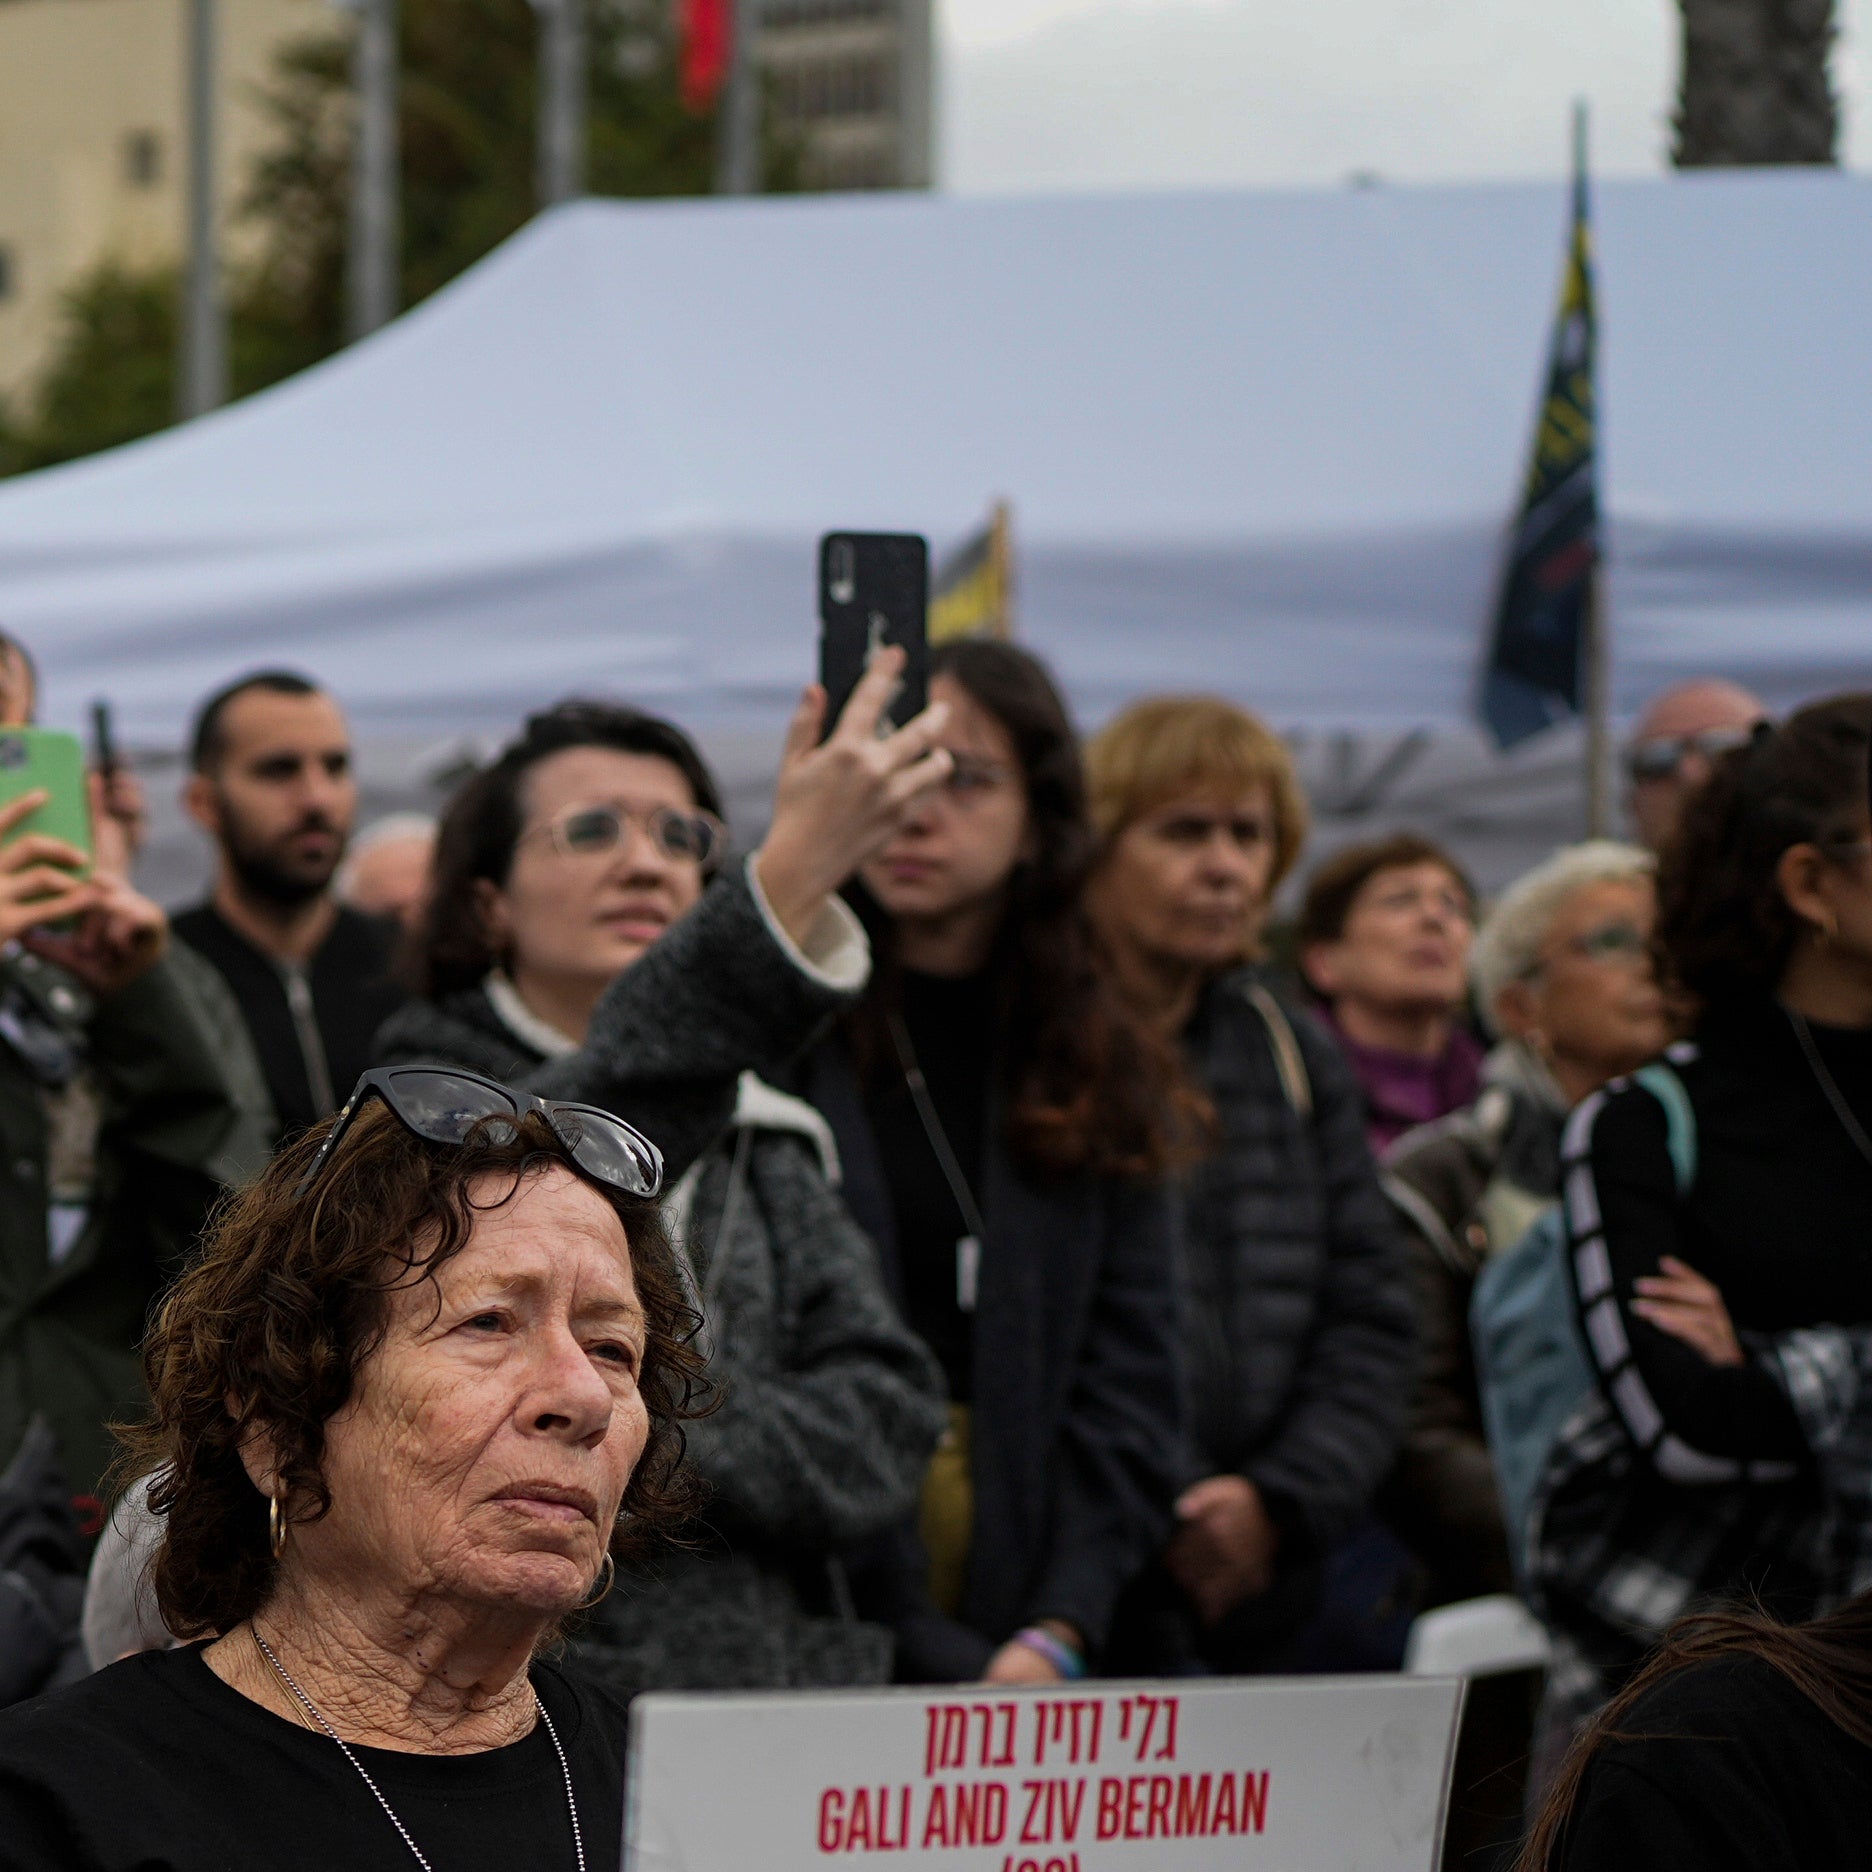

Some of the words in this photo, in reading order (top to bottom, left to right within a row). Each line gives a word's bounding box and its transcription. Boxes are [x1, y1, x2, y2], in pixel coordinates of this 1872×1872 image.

[925, 1703, 1018, 1778] ברמן
[1033, 1699, 1104, 1765] וזיו
[1120, 1694, 1179, 1762] גלי
[818, 1785, 911, 1852] GALI
[922, 1782, 1008, 1848] AND
[1018, 1778, 1086, 1844] ZIV
[1096, 1771, 1270, 1841] BERMAN
